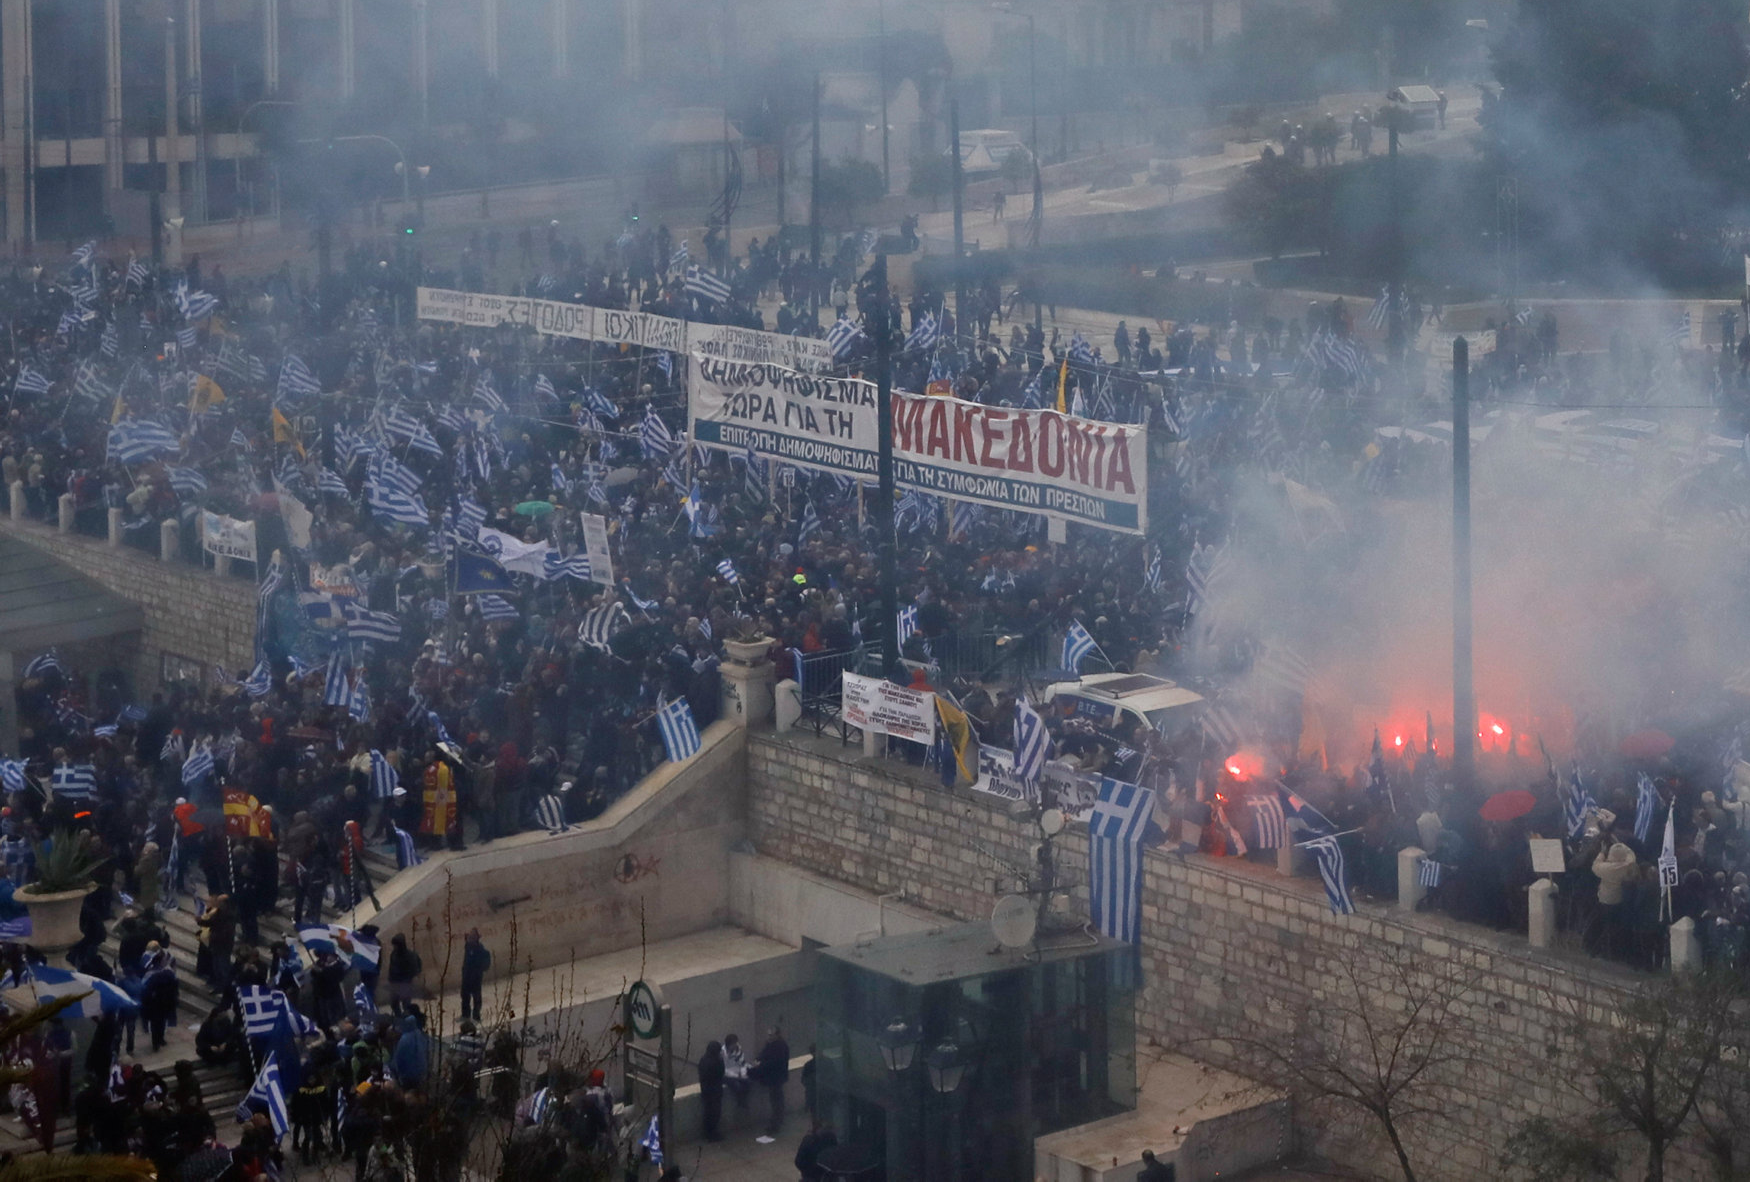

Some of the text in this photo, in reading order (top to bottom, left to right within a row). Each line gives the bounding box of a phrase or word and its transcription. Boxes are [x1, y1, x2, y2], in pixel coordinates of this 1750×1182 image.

[700, 357, 876, 409] ΔΗΜΟΨΗΦΙΣΜΑ
[722, 392, 853, 440] ΤΩΡΑ ΓΙΑ ΤΗ
[891, 395, 1136, 494] ΜΑΚΕΔΟΝΙΑ
[720, 425, 1105, 519] ΕΠΙΤΡΟΠΗ ΔΗΜΟΨΗΦΙΣΜΑΤ ΓΙΑ ΤΗ ΣΥΜΦΩΝΙΑ ΤΩΝ ΠΡΕΣΠΩΝ
[784, 474, 794, 486] 12
[1661, 866, 1677, 885] 15
